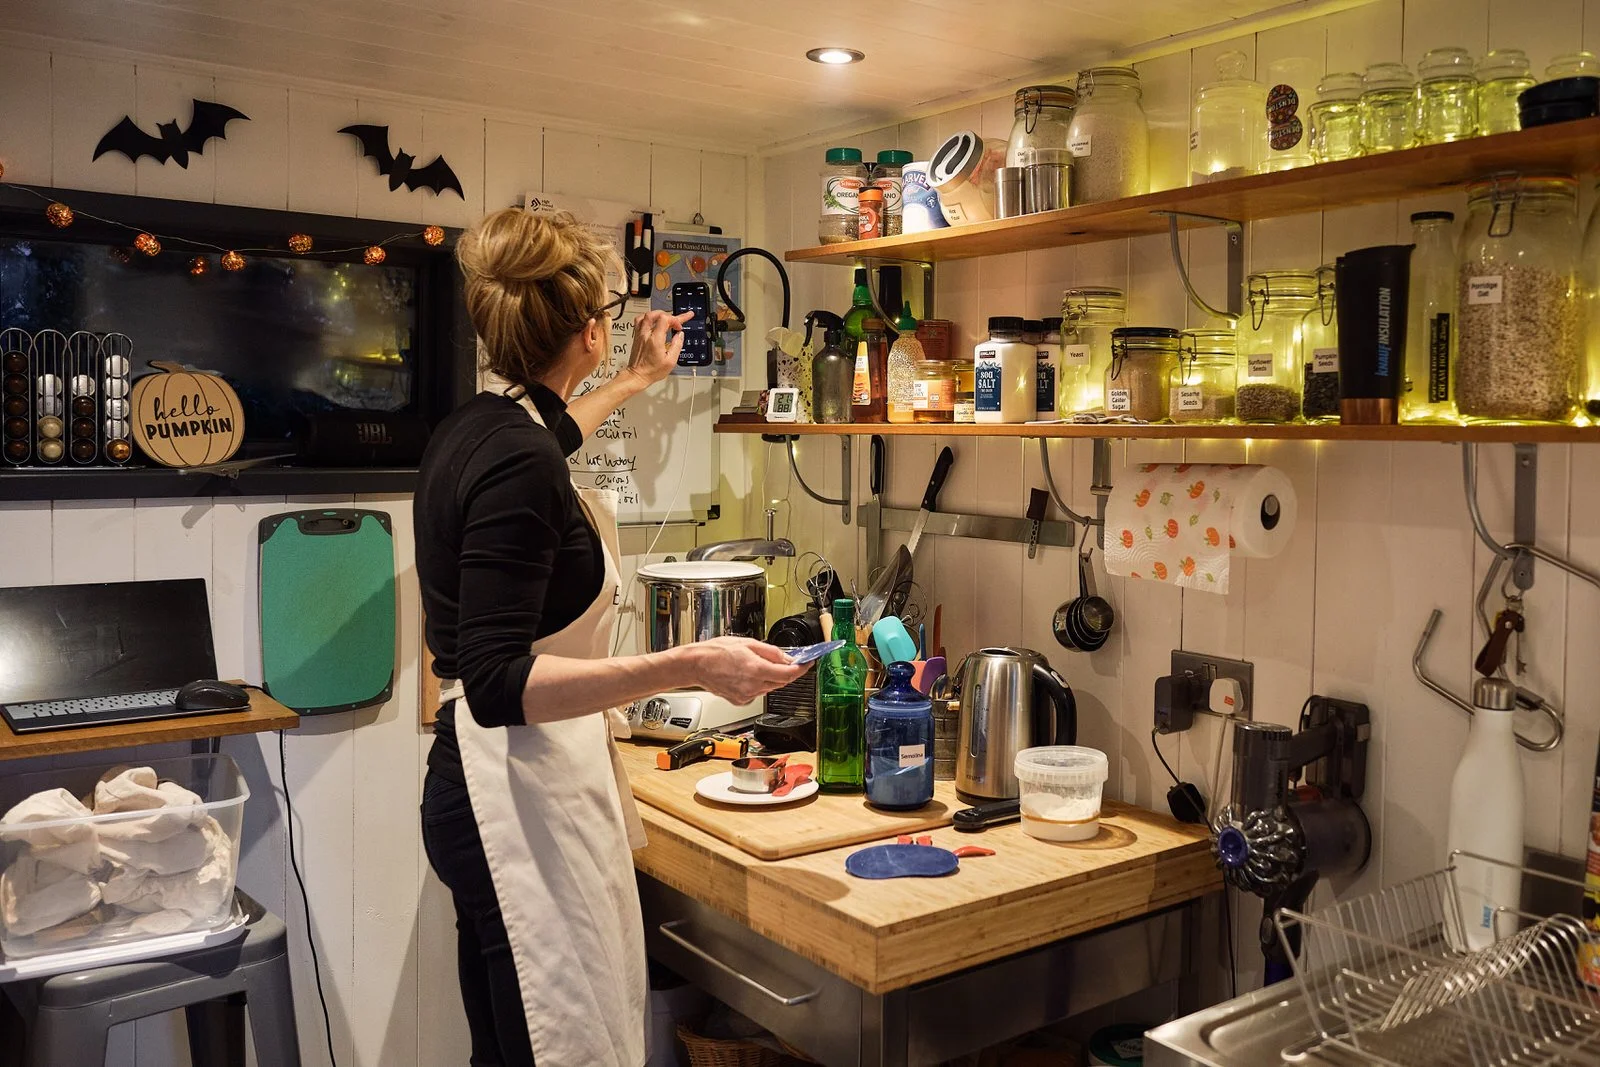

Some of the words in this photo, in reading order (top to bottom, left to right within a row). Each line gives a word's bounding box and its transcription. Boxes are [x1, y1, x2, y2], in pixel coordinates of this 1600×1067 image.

[978, 379, 996, 389] SALT
[154, 394, 220, 421] hello
[145, 417, 232, 440] PUMPKIN
[356, 423, 393, 444] JBL
